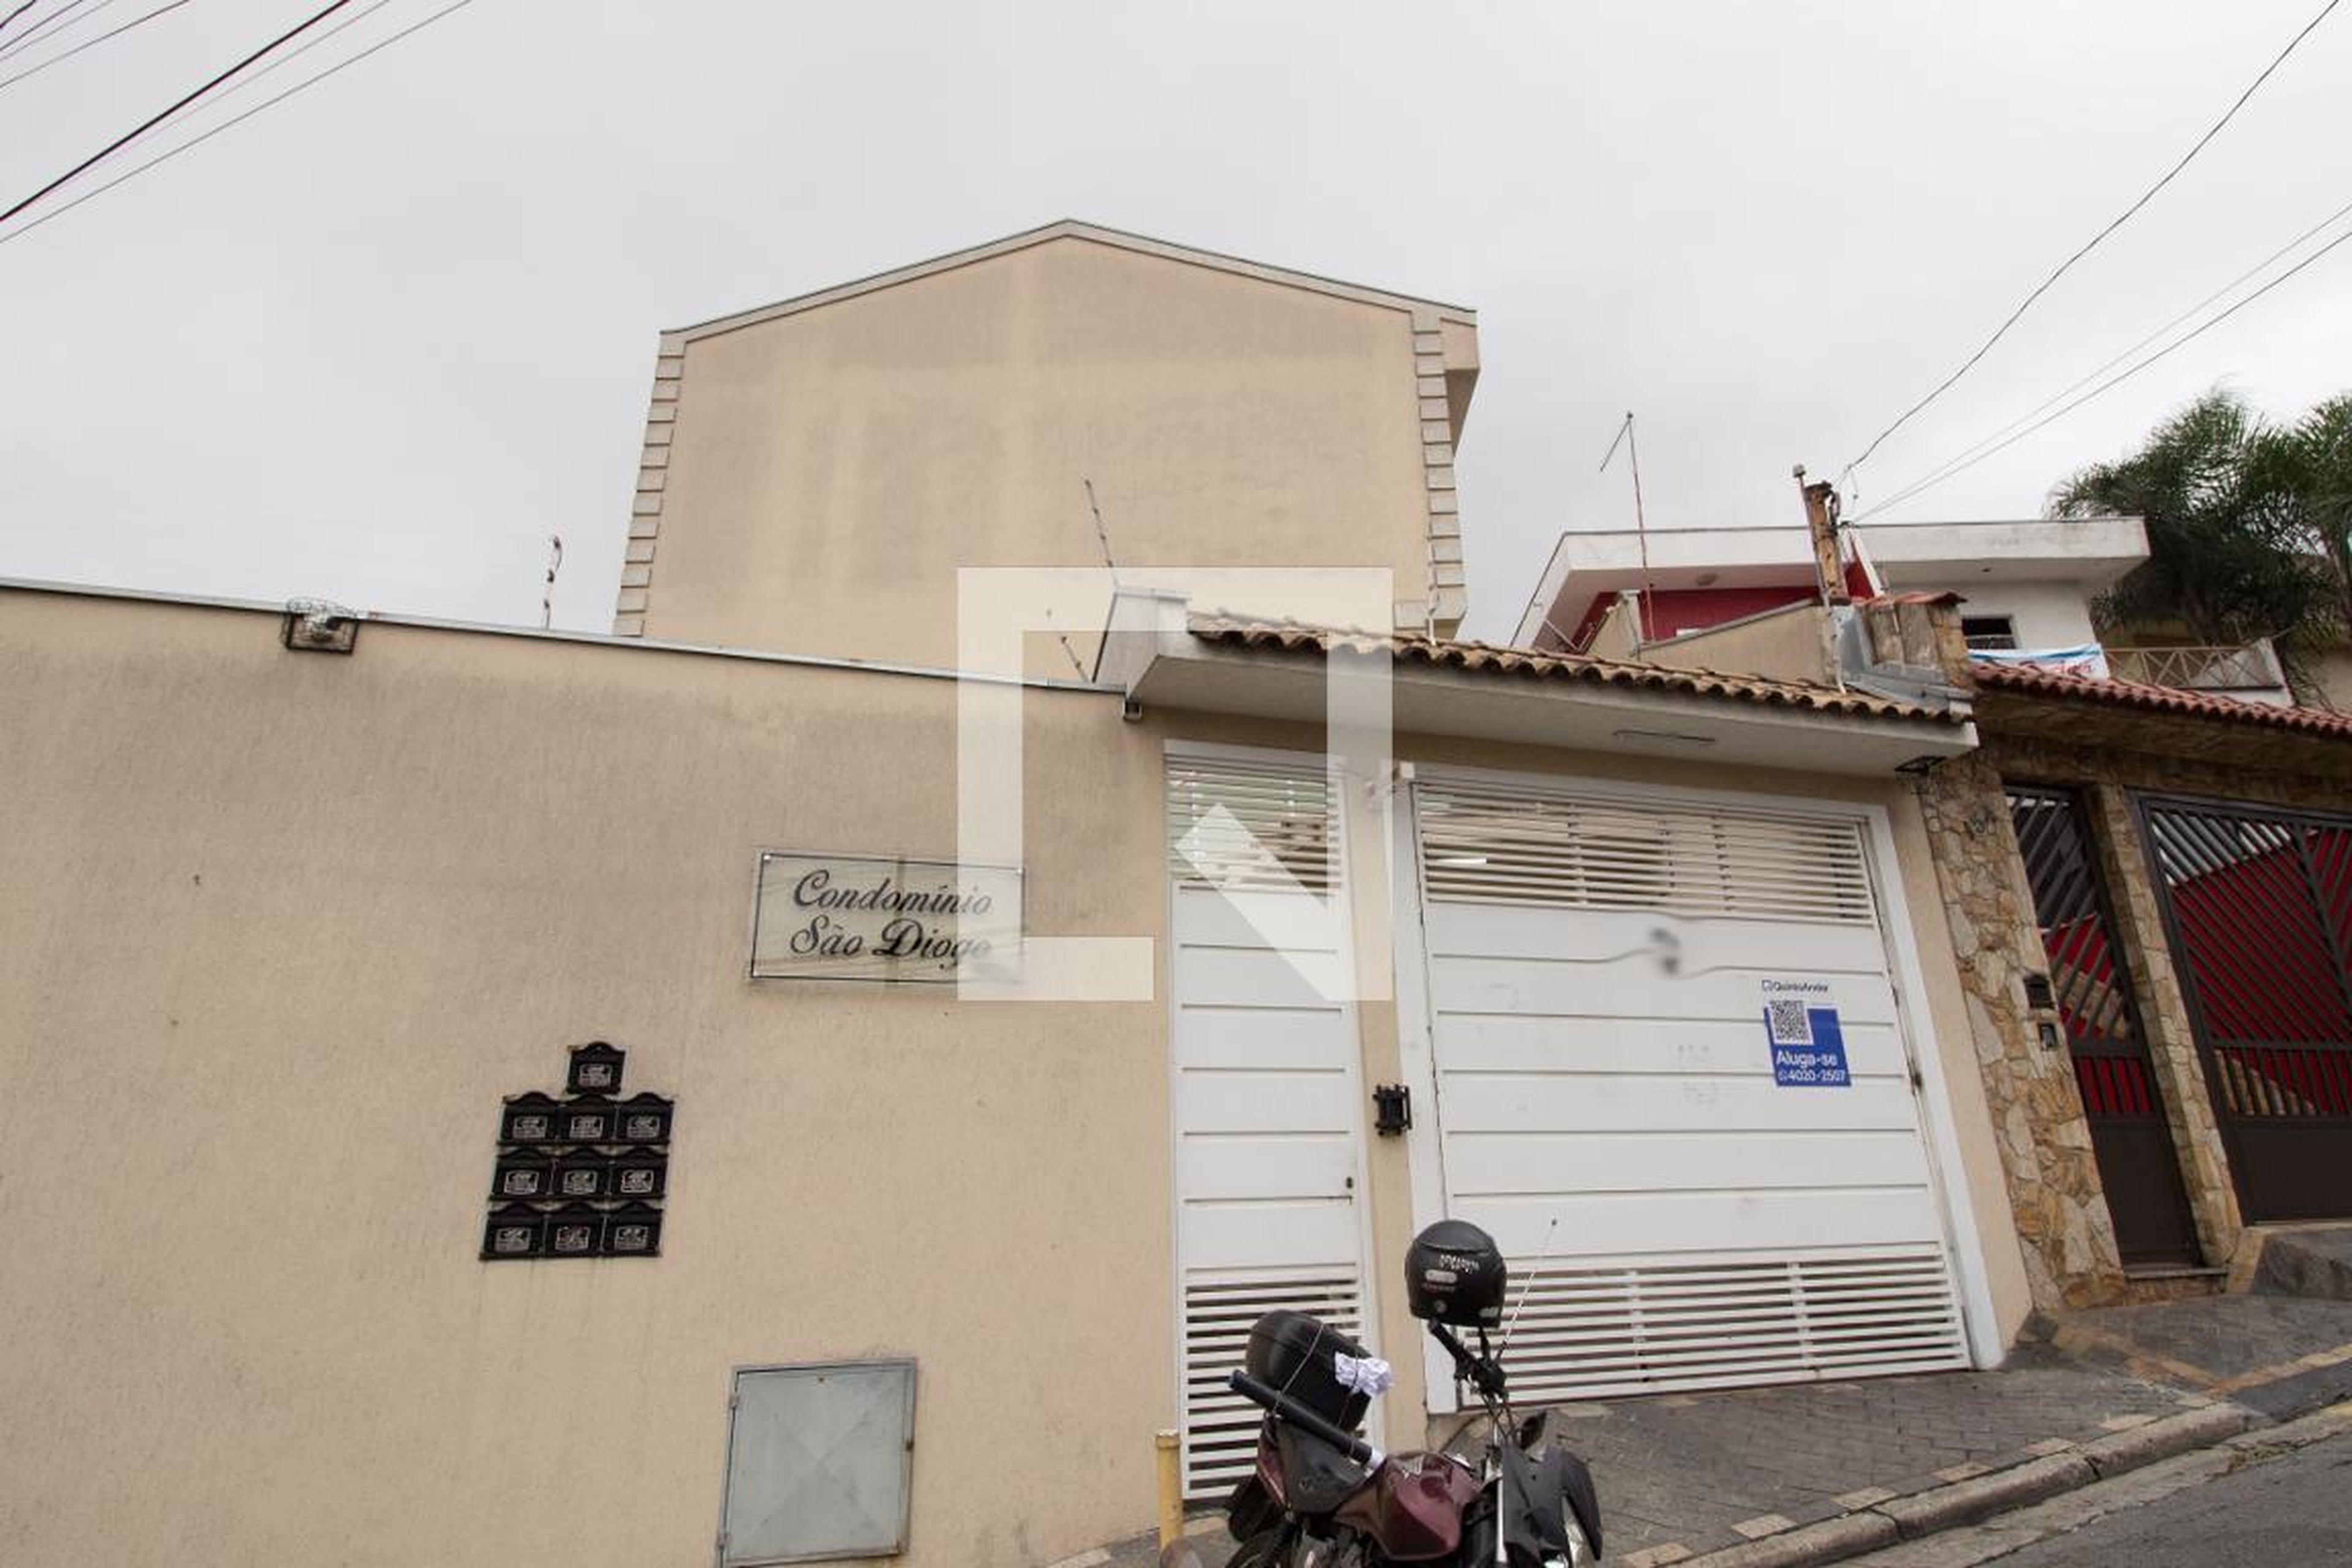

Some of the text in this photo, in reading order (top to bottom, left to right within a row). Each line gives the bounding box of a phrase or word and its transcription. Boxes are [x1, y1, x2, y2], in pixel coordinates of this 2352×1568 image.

[794, 869, 993, 916] Condomínio
[790, 914, 993, 970] São Diogo
[1776, 1049, 1838, 1069] Aluga-se
